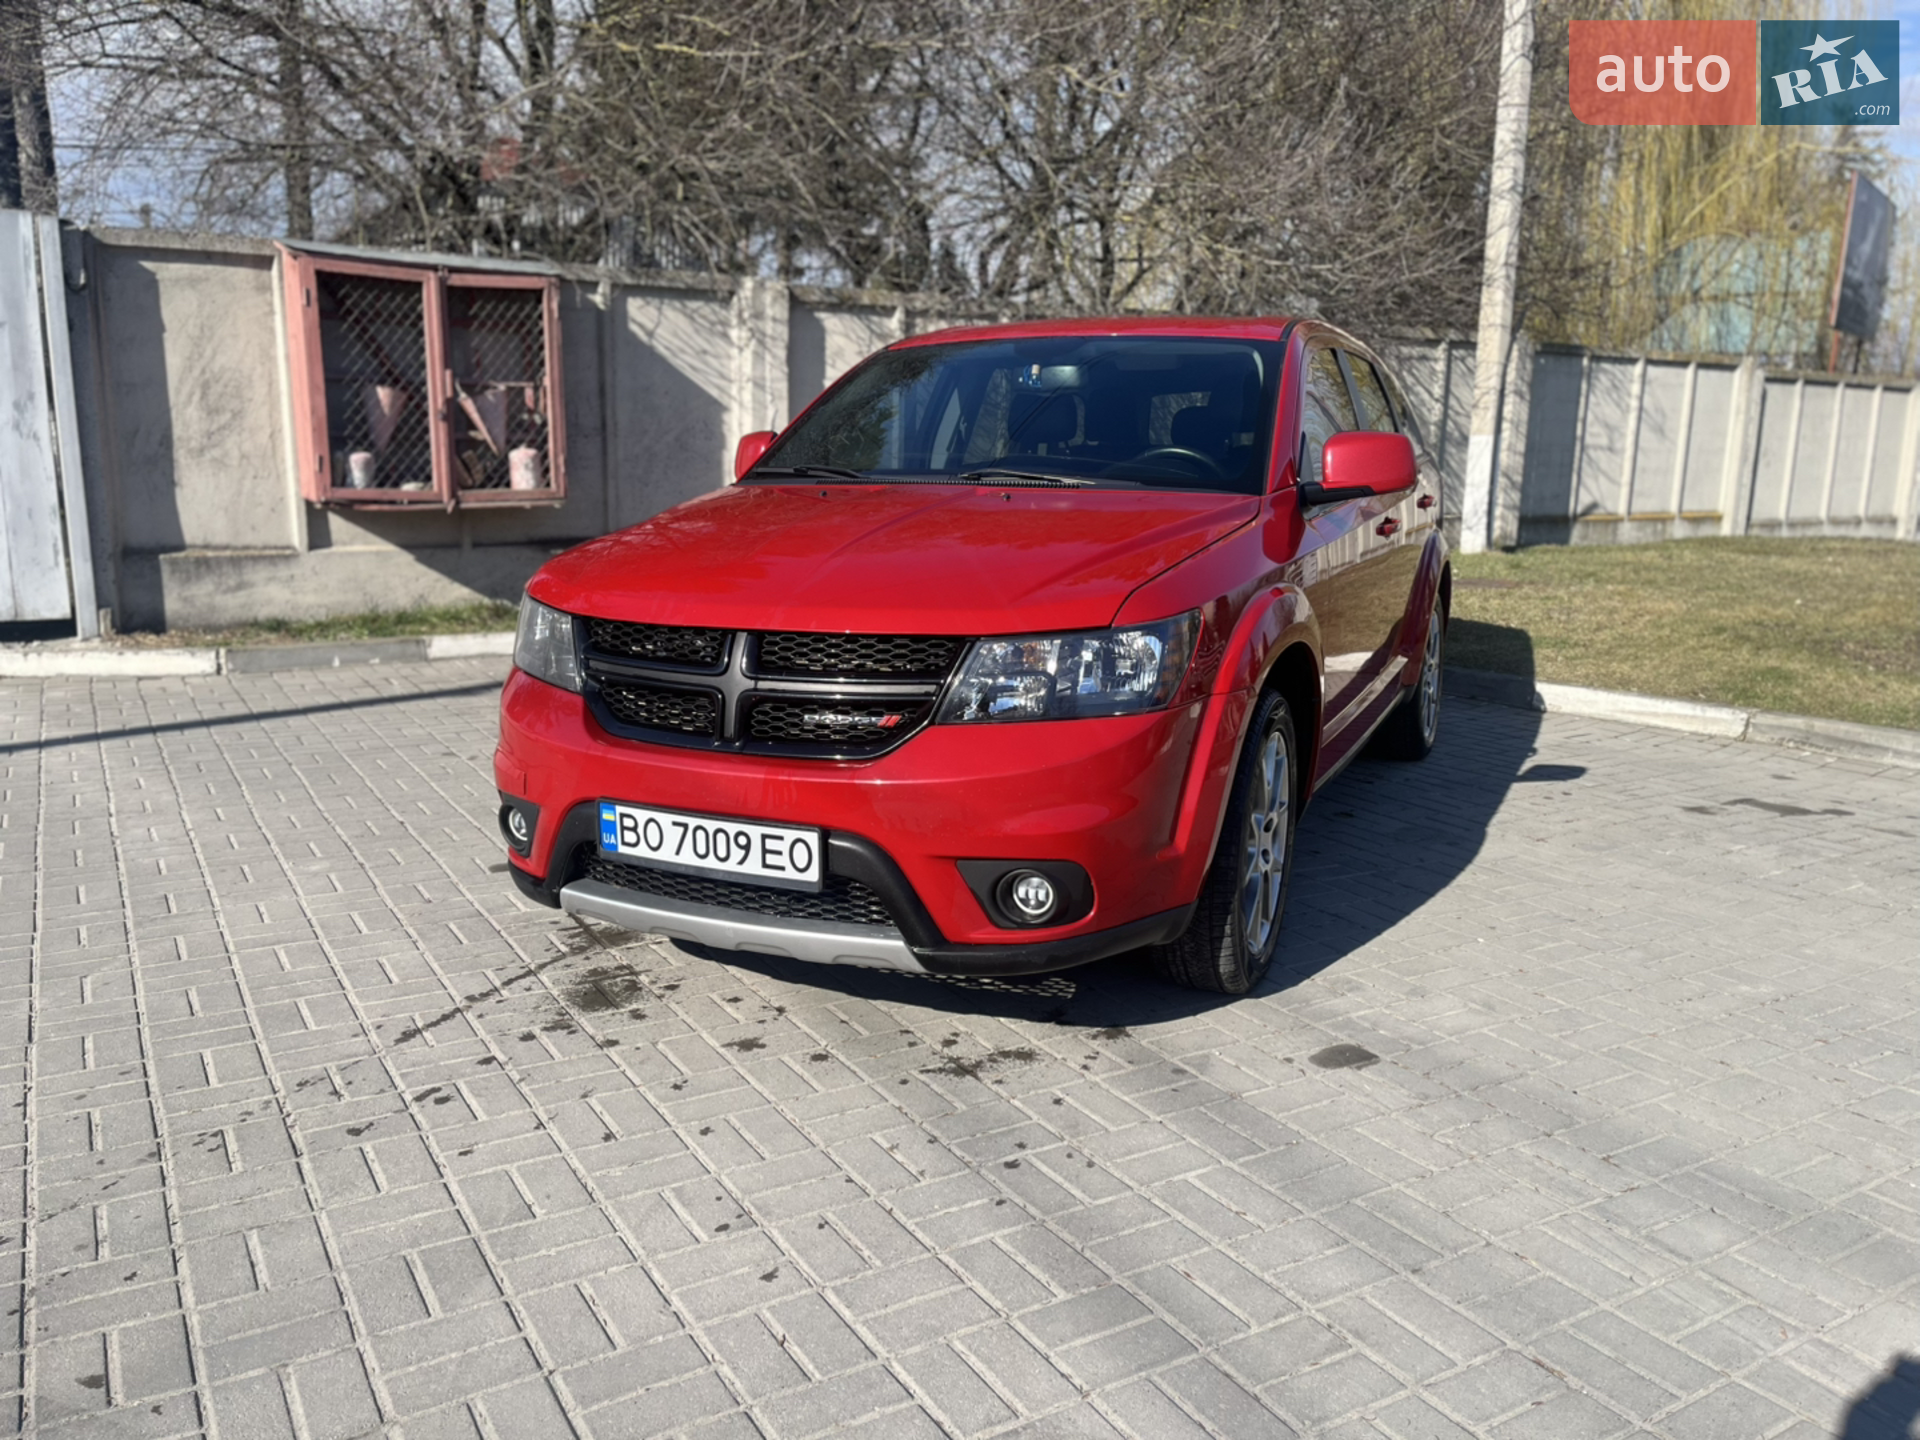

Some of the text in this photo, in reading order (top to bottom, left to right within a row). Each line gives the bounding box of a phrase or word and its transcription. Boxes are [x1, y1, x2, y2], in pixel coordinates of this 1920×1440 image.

[603, 831, 617, 846] UA
[619, 812, 813, 873] BO 7009 EO
